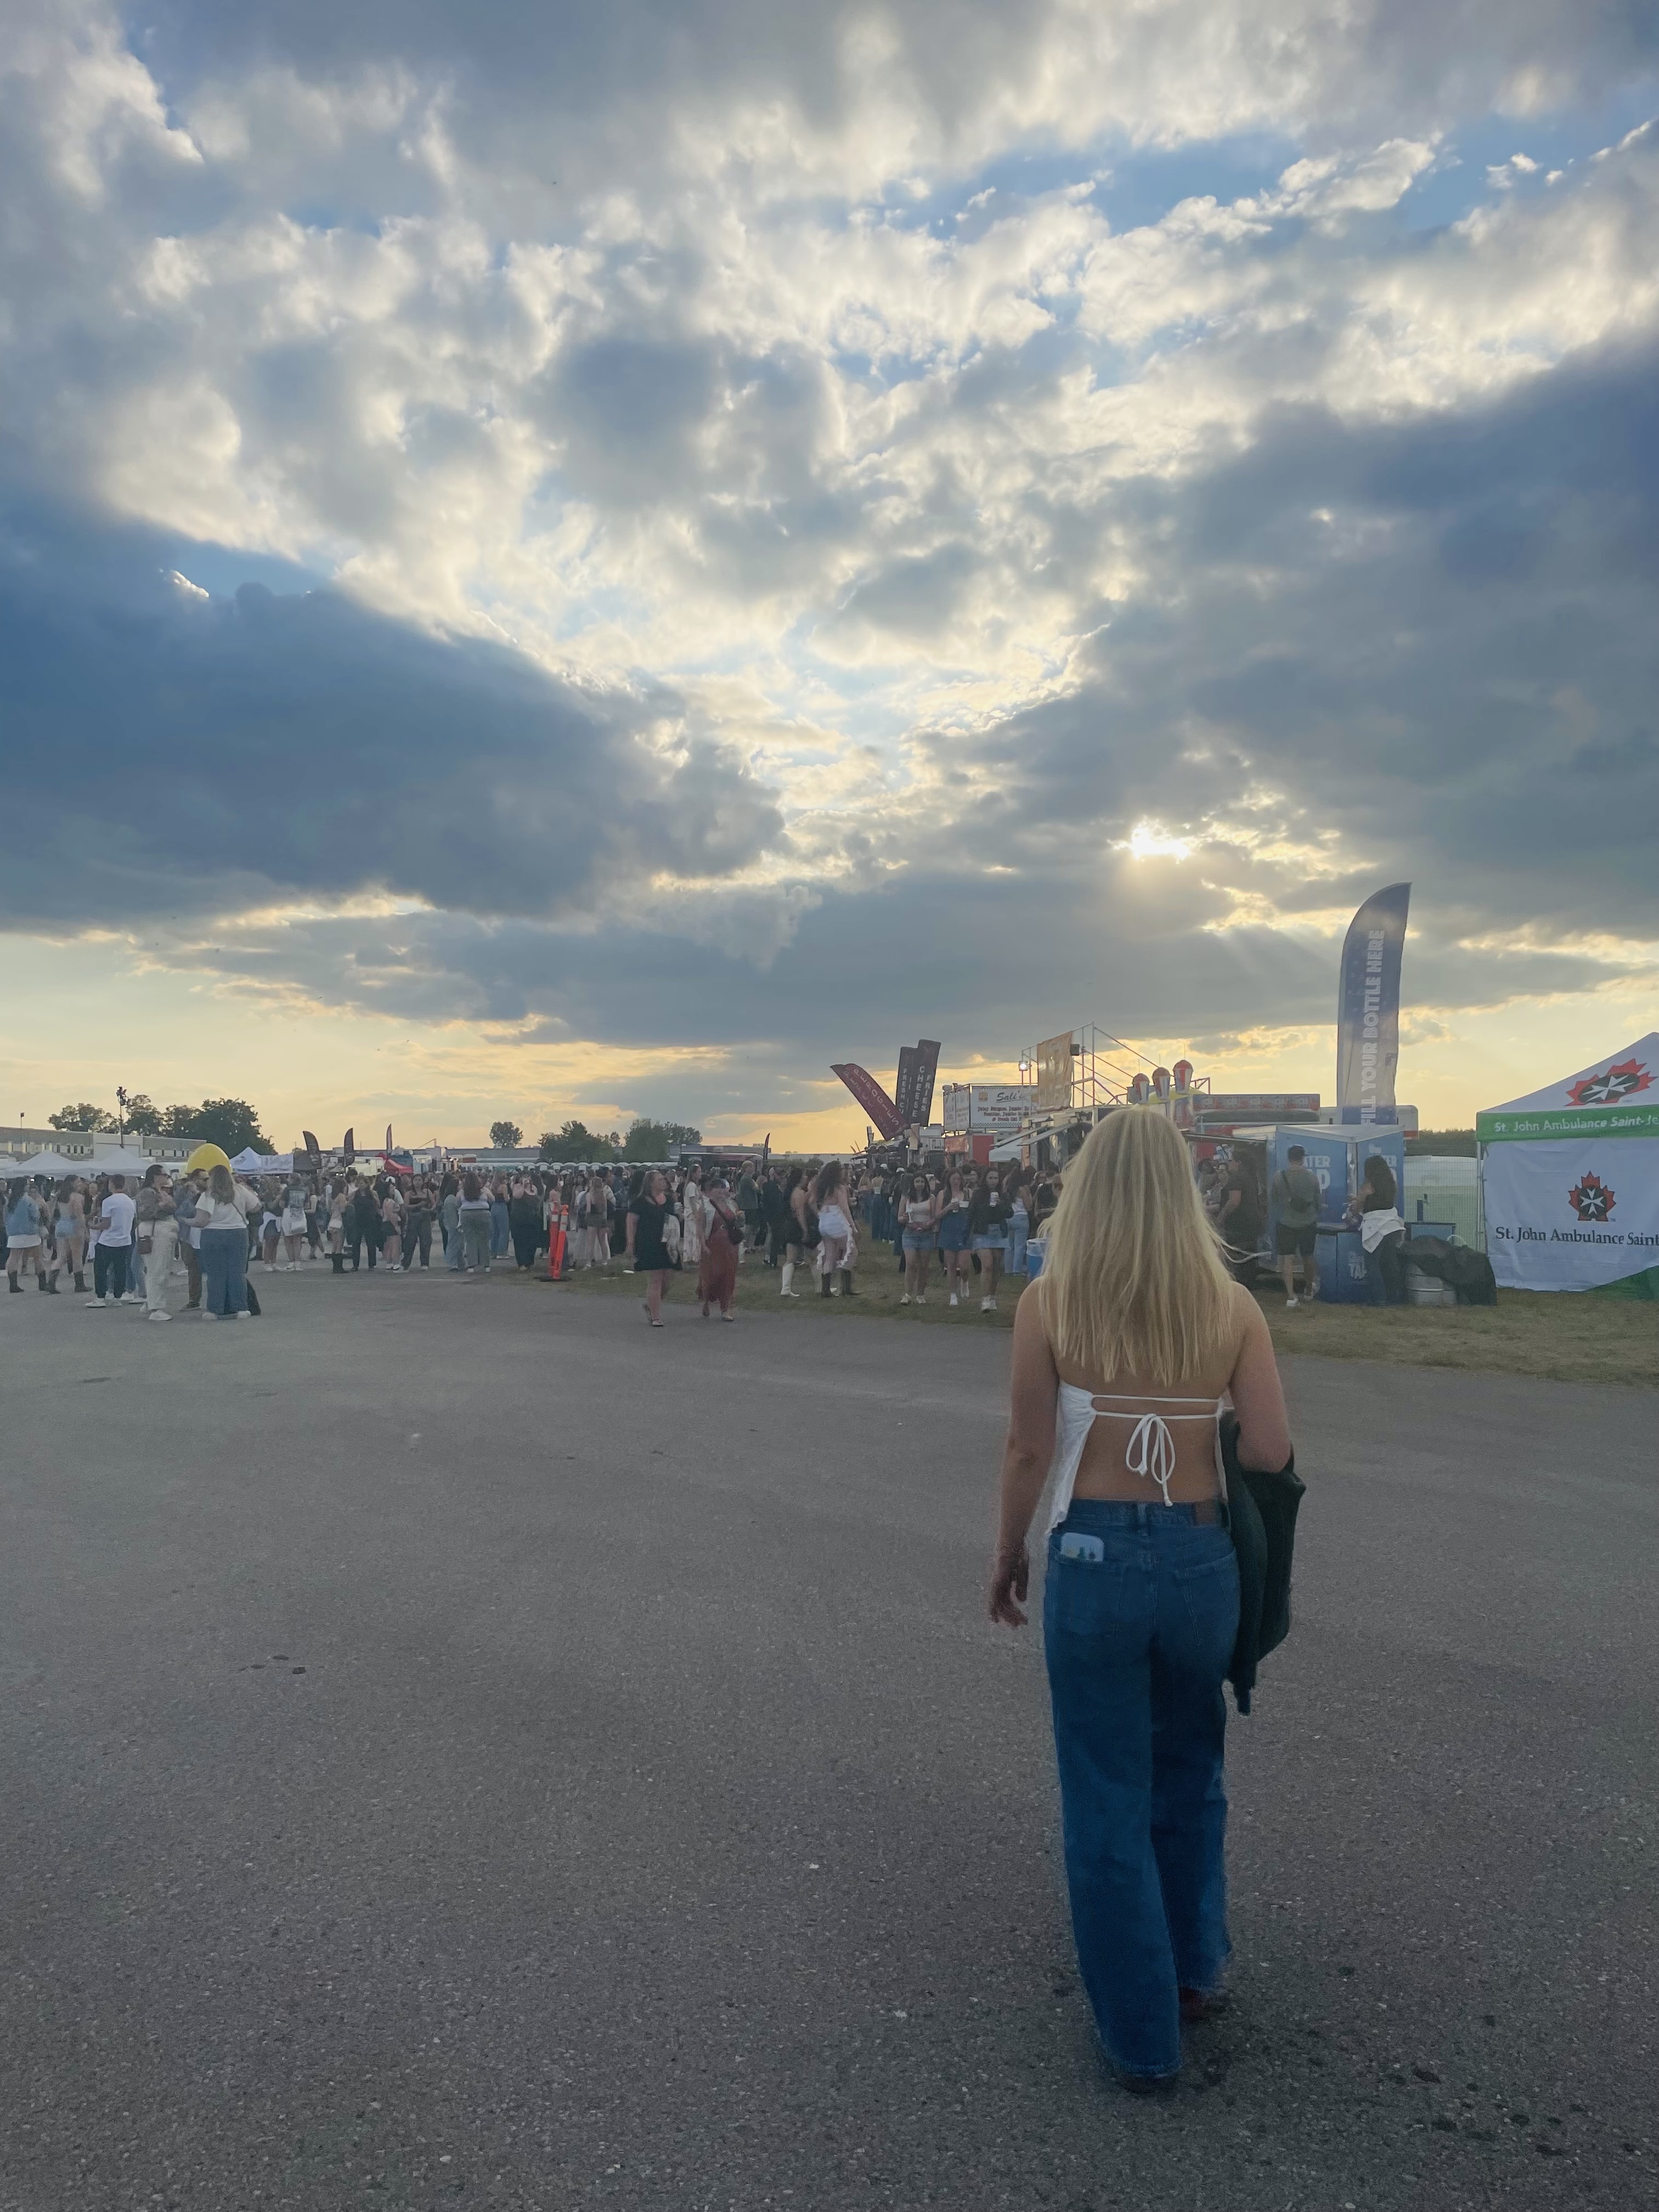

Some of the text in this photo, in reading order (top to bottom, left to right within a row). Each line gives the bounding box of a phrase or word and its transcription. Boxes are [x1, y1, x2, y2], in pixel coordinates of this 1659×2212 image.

[1367, 930, 1385, 972] HERE
[1363, 977, 1381, 1038] BOTTLE
[1361, 1042, 1378, 1092] YOUR
[854, 1068, 899, 1125] PEROGIES
[912, 1065, 926, 1117] CHEESE
[921, 1074, 932, 1111] FRIES
[1513, 1120, 1540, 1132] John
[1543, 1118, 1607, 1131] Ambulance
[1496, 1226, 1514, 1239] St.
[1516, 1227, 1546, 1243] John
[1550, 1228, 1624, 1244] Ambulance
